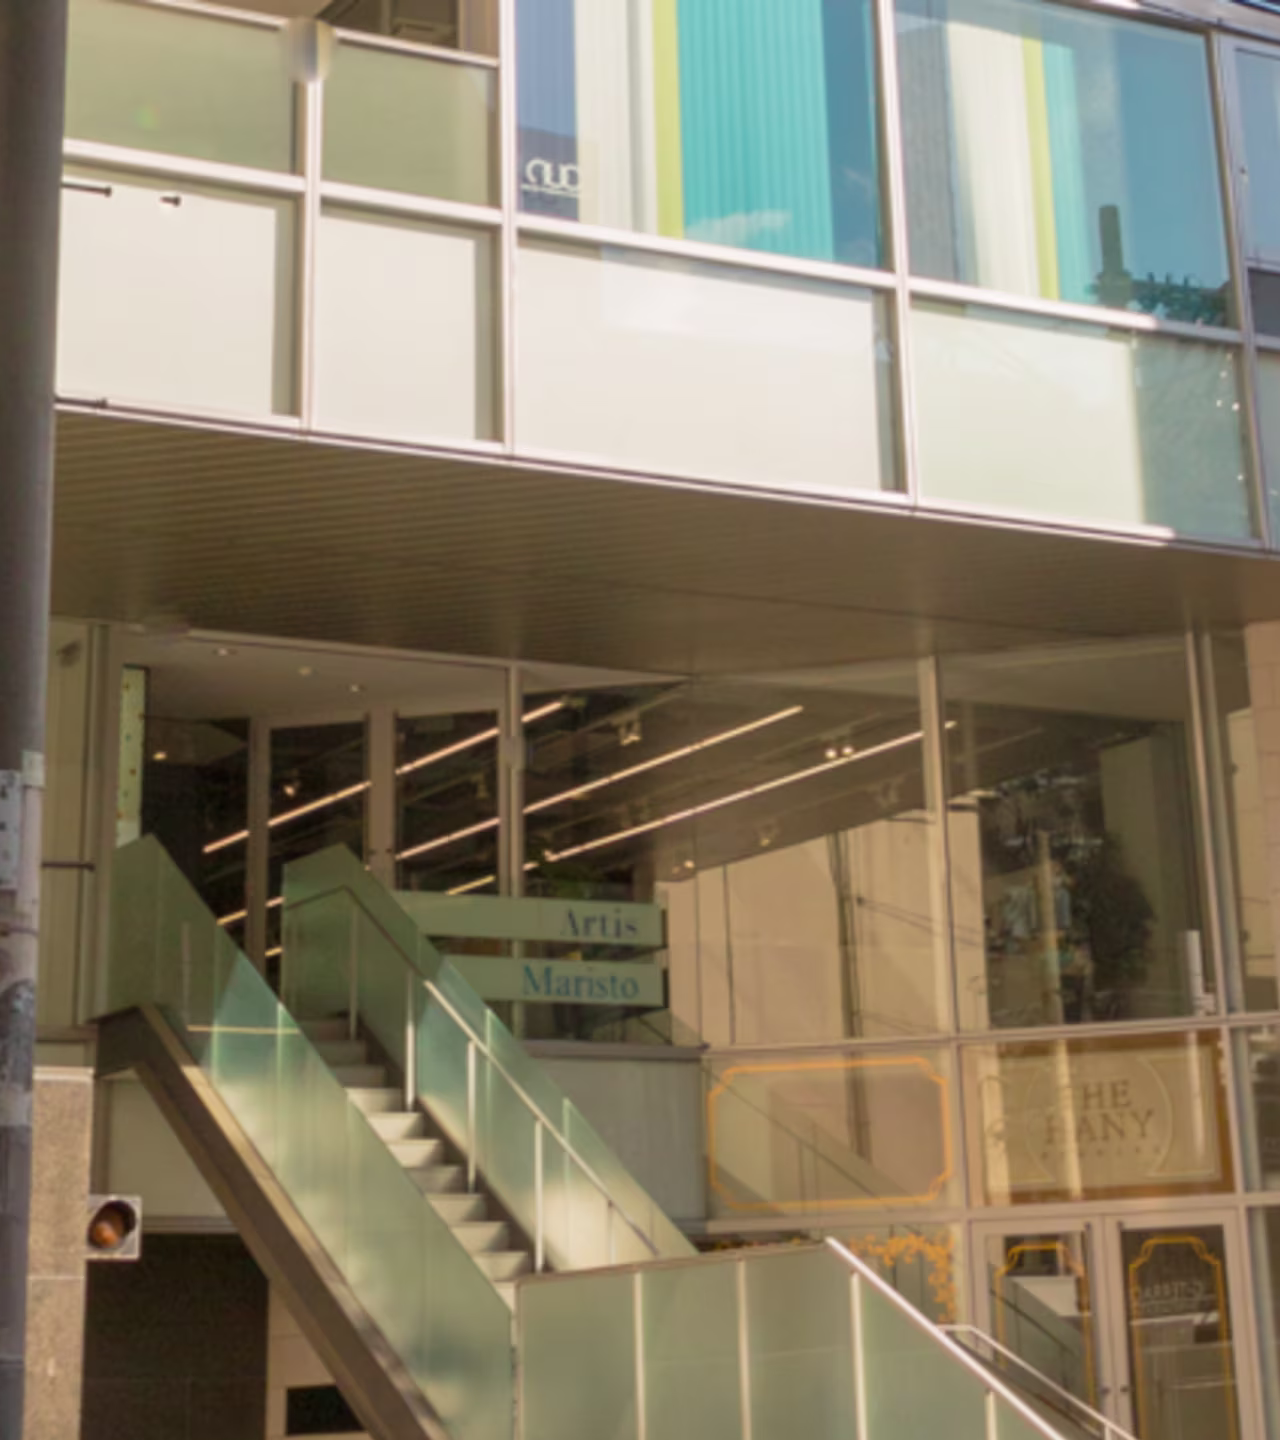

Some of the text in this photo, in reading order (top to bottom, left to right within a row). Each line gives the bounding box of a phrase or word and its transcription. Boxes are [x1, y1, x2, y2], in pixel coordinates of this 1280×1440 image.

[560, 908, 638, 938] Artis
[522, 963, 640, 1000] Maristo
[1067, 1078, 1133, 1110] HE
